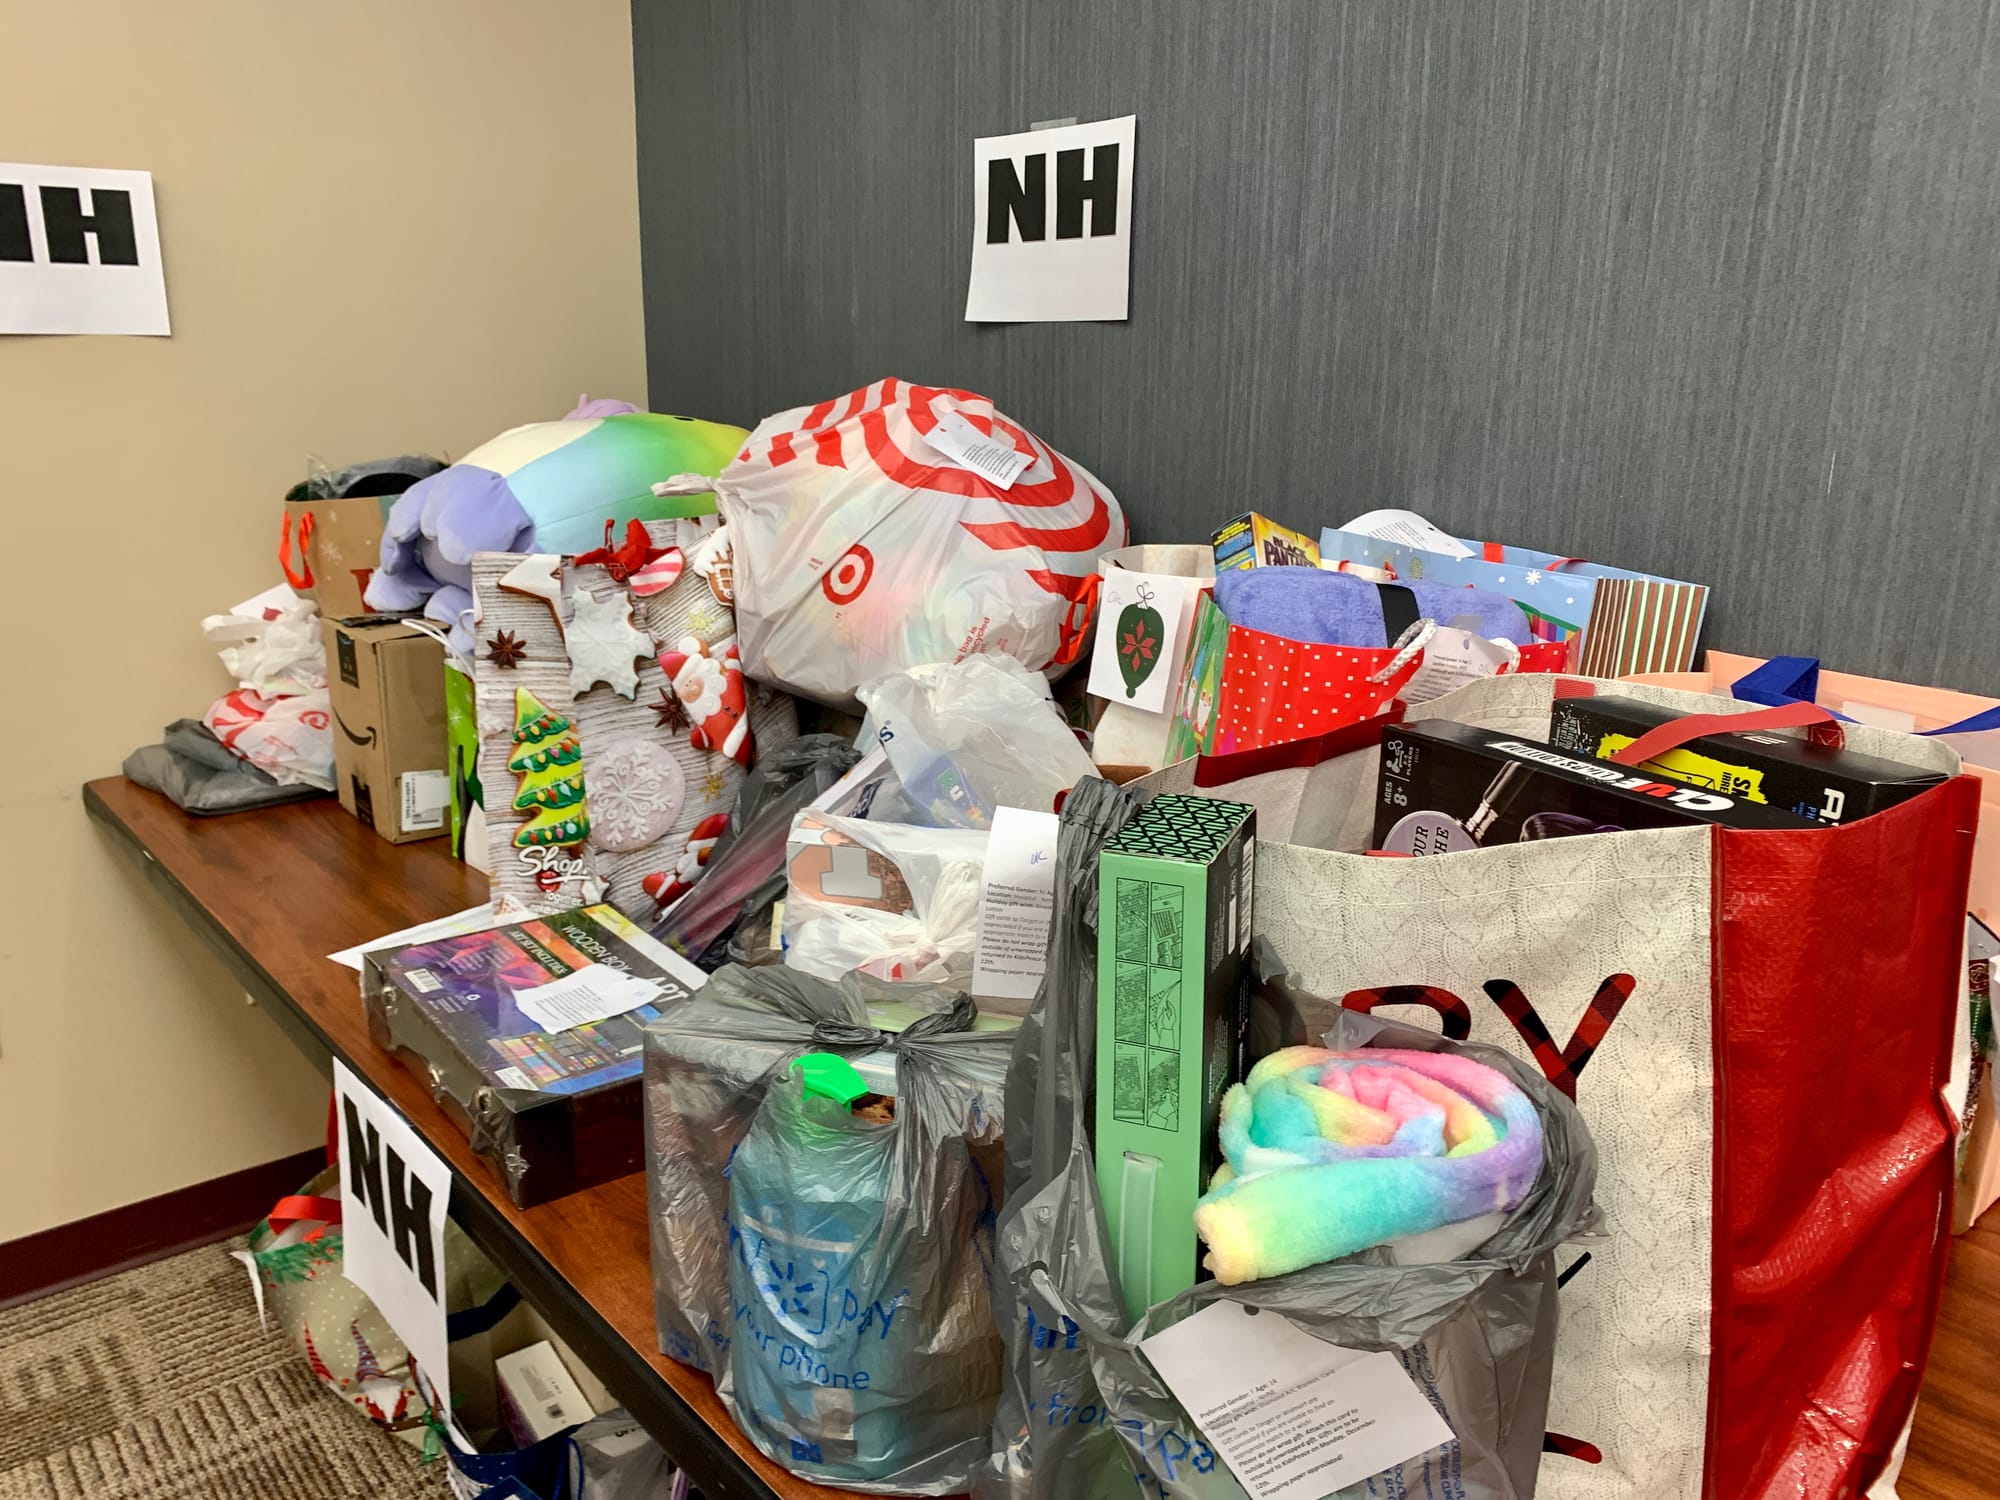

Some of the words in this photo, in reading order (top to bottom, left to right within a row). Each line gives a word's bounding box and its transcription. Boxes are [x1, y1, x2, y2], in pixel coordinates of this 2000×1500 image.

[987, 144, 1119, 243] NH
[1272, 535, 1306, 558] BLACK
[958, 635, 974, 653] bag
[969, 616, 991, 653] recycled
[1384, 781, 1393, 805] AGES
[1393, 785, 1408, 807] 8+
[1611, 779, 1735, 811] CLUE
[986, 898, 1008, 906] Holiday
[988, 882, 1014, 891] Preferred
[562, 924, 609, 961] WOODEN
[601, 954, 632, 978] BOX
[345, 1095, 438, 1303] NH
[779, 1343, 872, 1391] phone
[1199, 1401, 1227, 1419] Preferred
[1226, 1390, 1250, 1405] Gender:
[1254, 1381, 1269, 1393] Age:
[1238, 1455, 1257, 1467] Please
[1256, 1450, 1266, 1458] do
[1266, 1446, 1276, 1454] not
[1276, 1439, 1292, 1450] wrap
[1305, 1422, 1325, 1436] Attach
[1324, 1417, 1337, 1426] this
[1336, 1410, 1351, 1421] card
[1256, 1415, 1276, 1429] Target
[1243, 1461, 1265, 1475] outside
[1305, 1435, 1318, 1446] gift.
[1317, 1428, 1333, 1440] Gifts
[1332, 1424, 1343, 1432] are
[1248, 1466, 1274, 1482] returned
[1281, 1448, 1310, 1466] KidsPeace
[1345, 1417, 1376, 1436] December
[1260, 1479, 1289, 1498] Wrapping
[1288, 1471, 1307, 1484] paper
